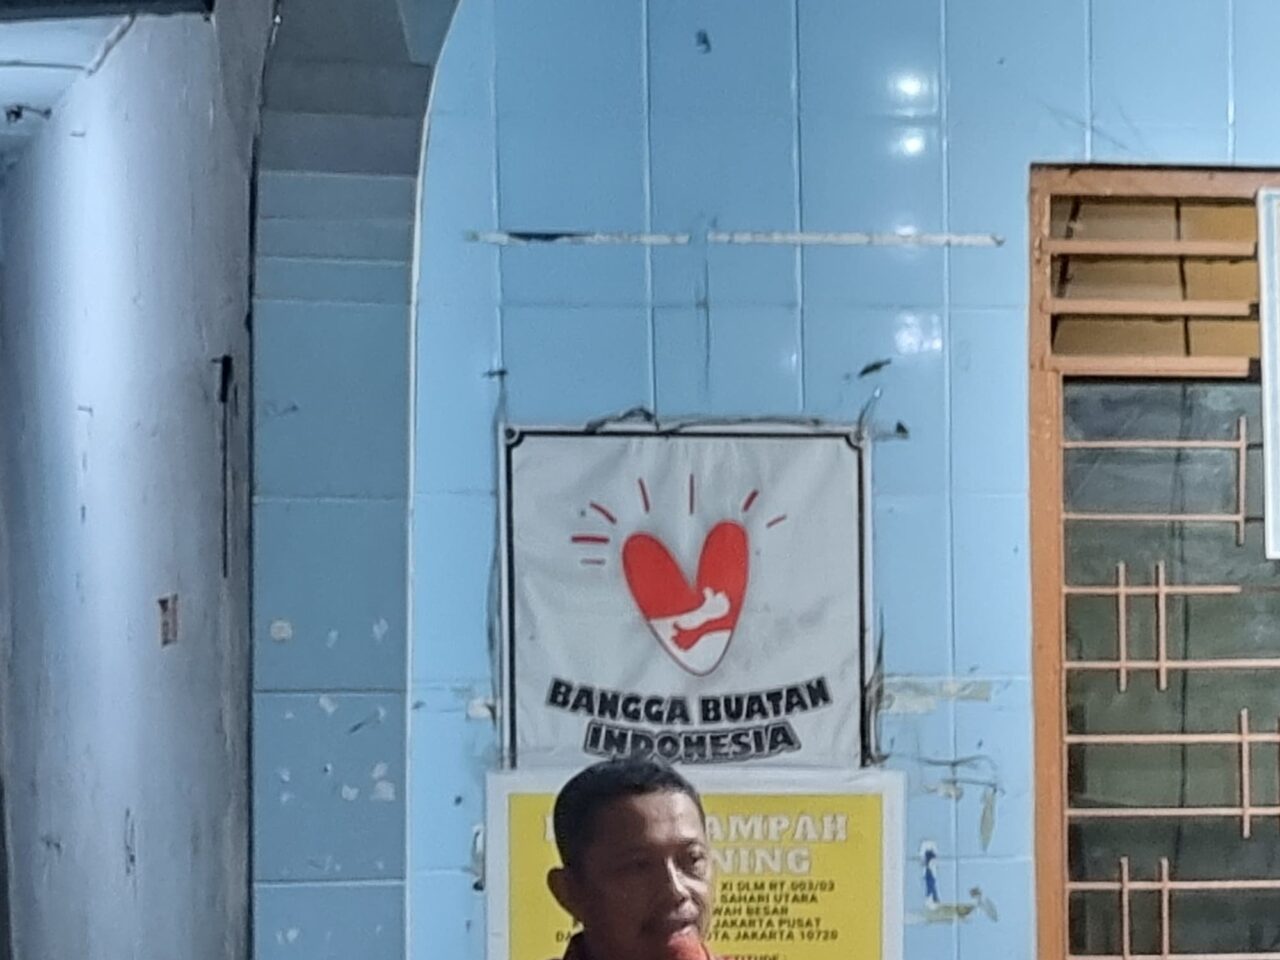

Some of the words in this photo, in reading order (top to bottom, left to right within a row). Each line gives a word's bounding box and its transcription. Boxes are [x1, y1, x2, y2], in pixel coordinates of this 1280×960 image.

[547, 676, 692, 725] BANGGA
[699, 675, 834, 723] BUATAN
[586, 719, 801, 763] INDONESIA
[705, 812, 848, 843] AMPAH
[711, 847, 812, 876] NING
[774, 893, 819, 904] UTARA
[712, 905, 743, 917] WAH
[746, 905, 789, 916] BESAR
[713, 917, 775, 929] JAKARTA
[778, 917, 822, 929] PUSAT
[735, 930, 795, 942] JAKARTA
